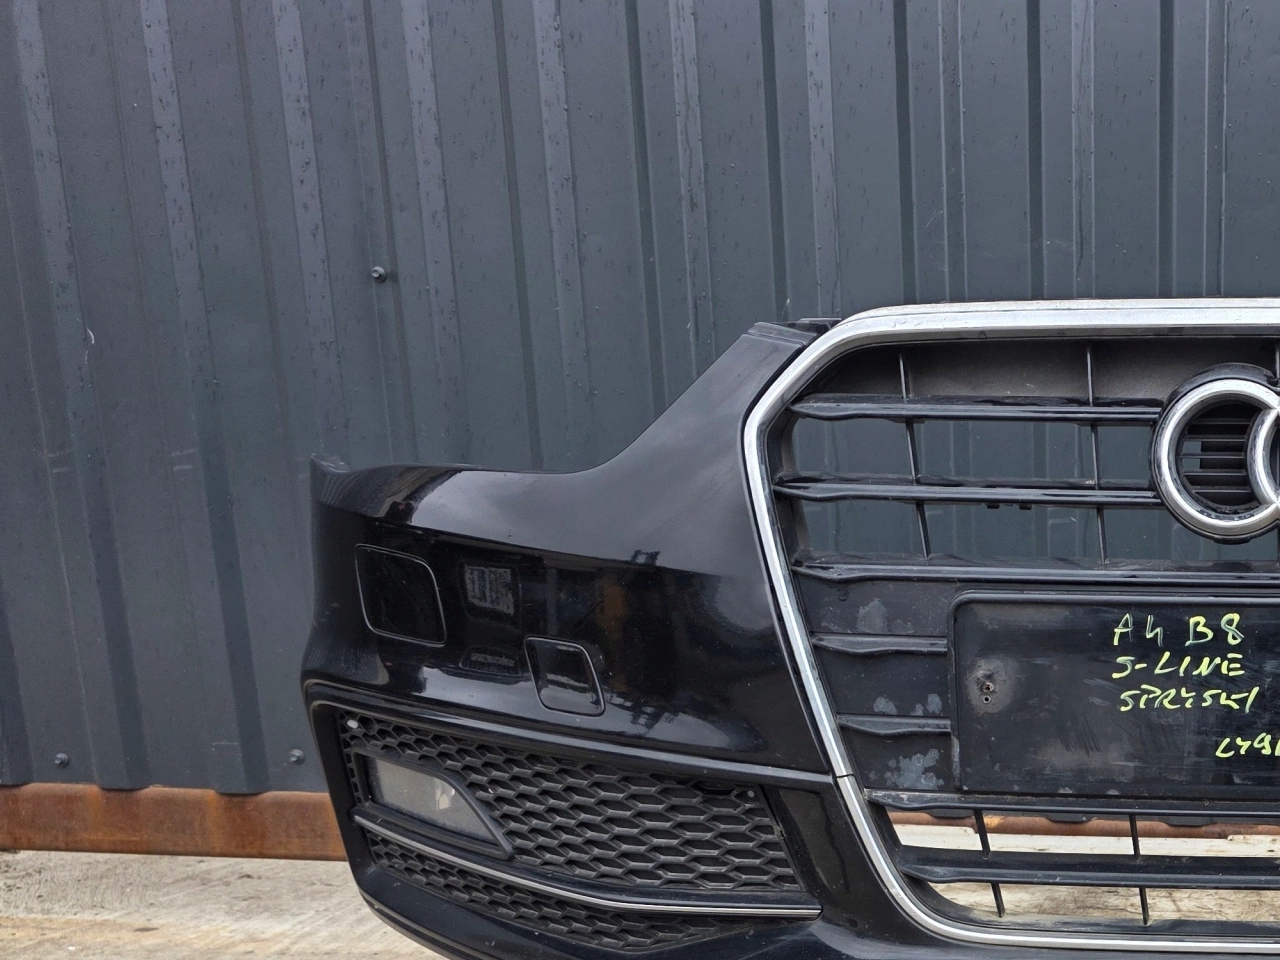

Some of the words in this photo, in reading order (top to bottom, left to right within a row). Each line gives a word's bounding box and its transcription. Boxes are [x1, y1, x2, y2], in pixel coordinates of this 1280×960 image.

[1112, 612, 1164, 648] A4
[1184, 612, 1245, 647] B8
[1111, 650, 1246, 679] S-LINE
